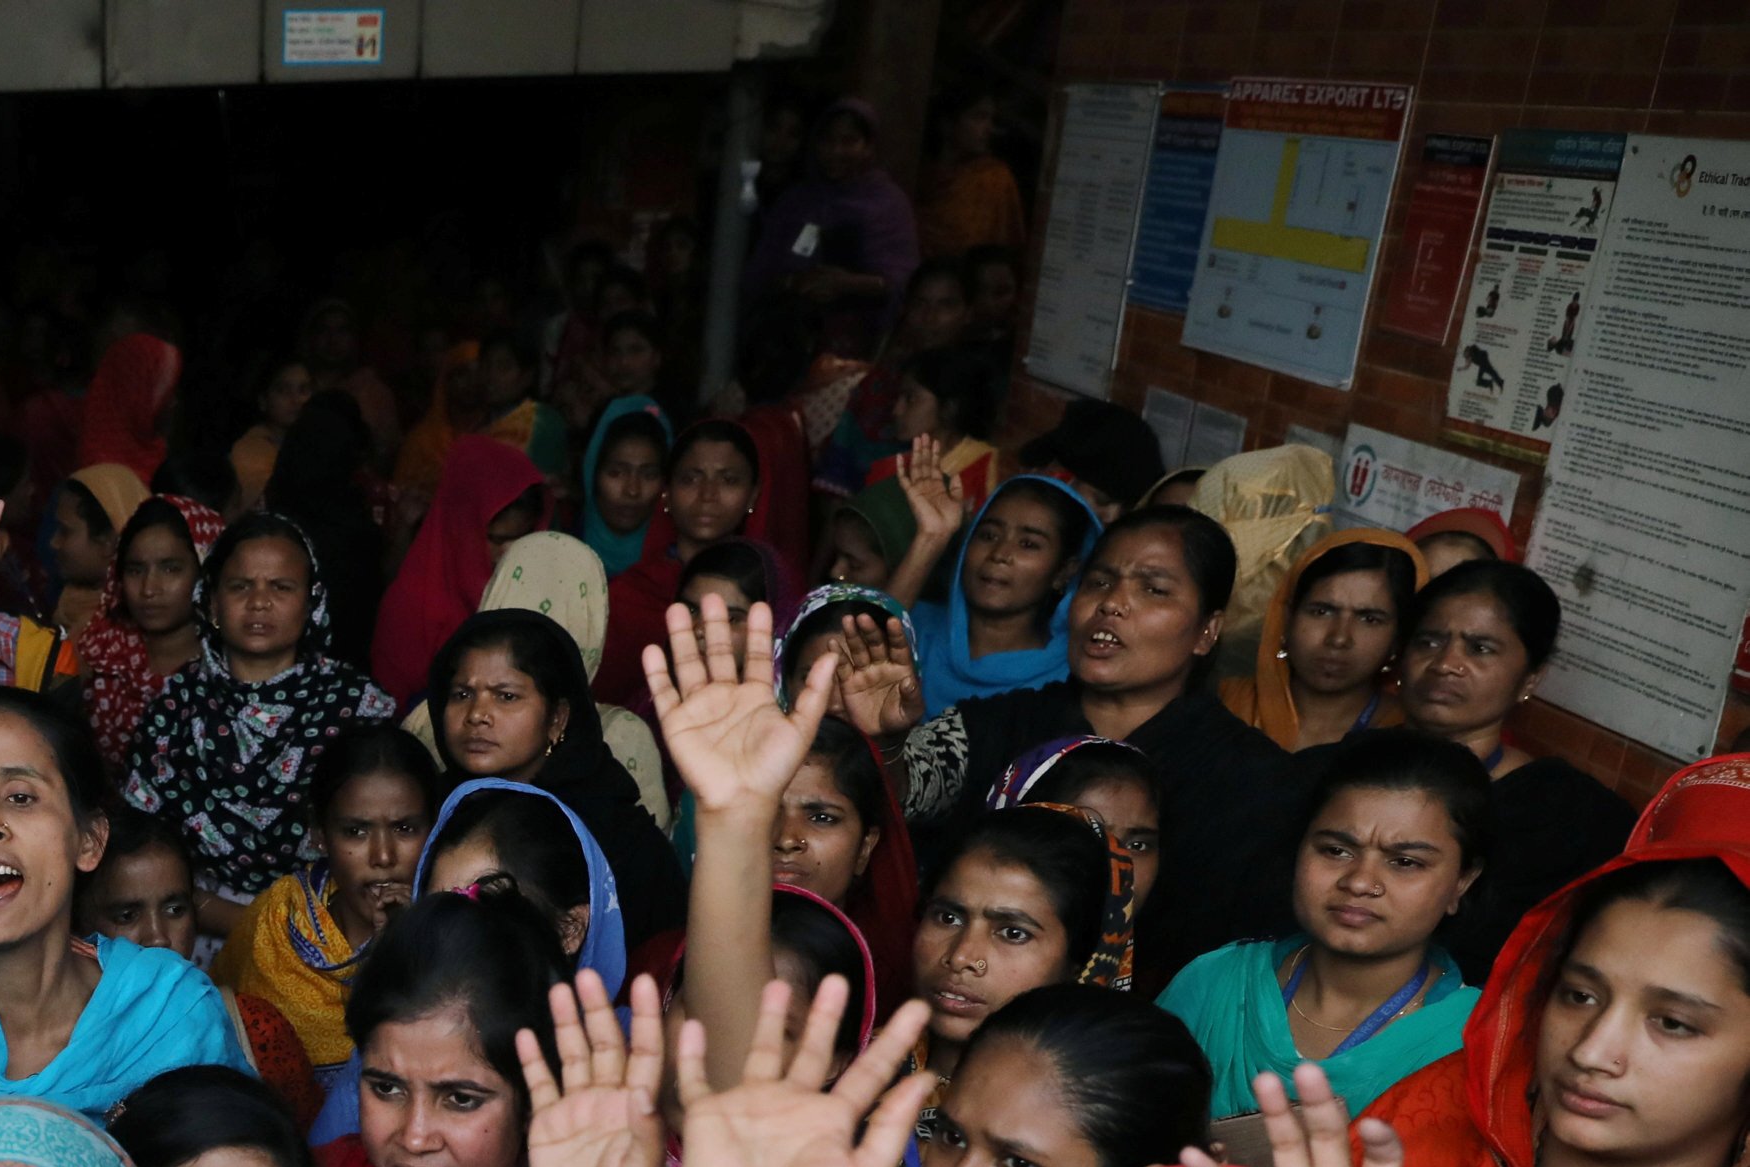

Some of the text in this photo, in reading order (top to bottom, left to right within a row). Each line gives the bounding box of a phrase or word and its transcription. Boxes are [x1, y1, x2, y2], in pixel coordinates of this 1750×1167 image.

[1231, 83, 1300, 103] APPAREL
[1305, 85, 1370, 107] EXPORT
[1698, 170, 1729, 185] Ethical
